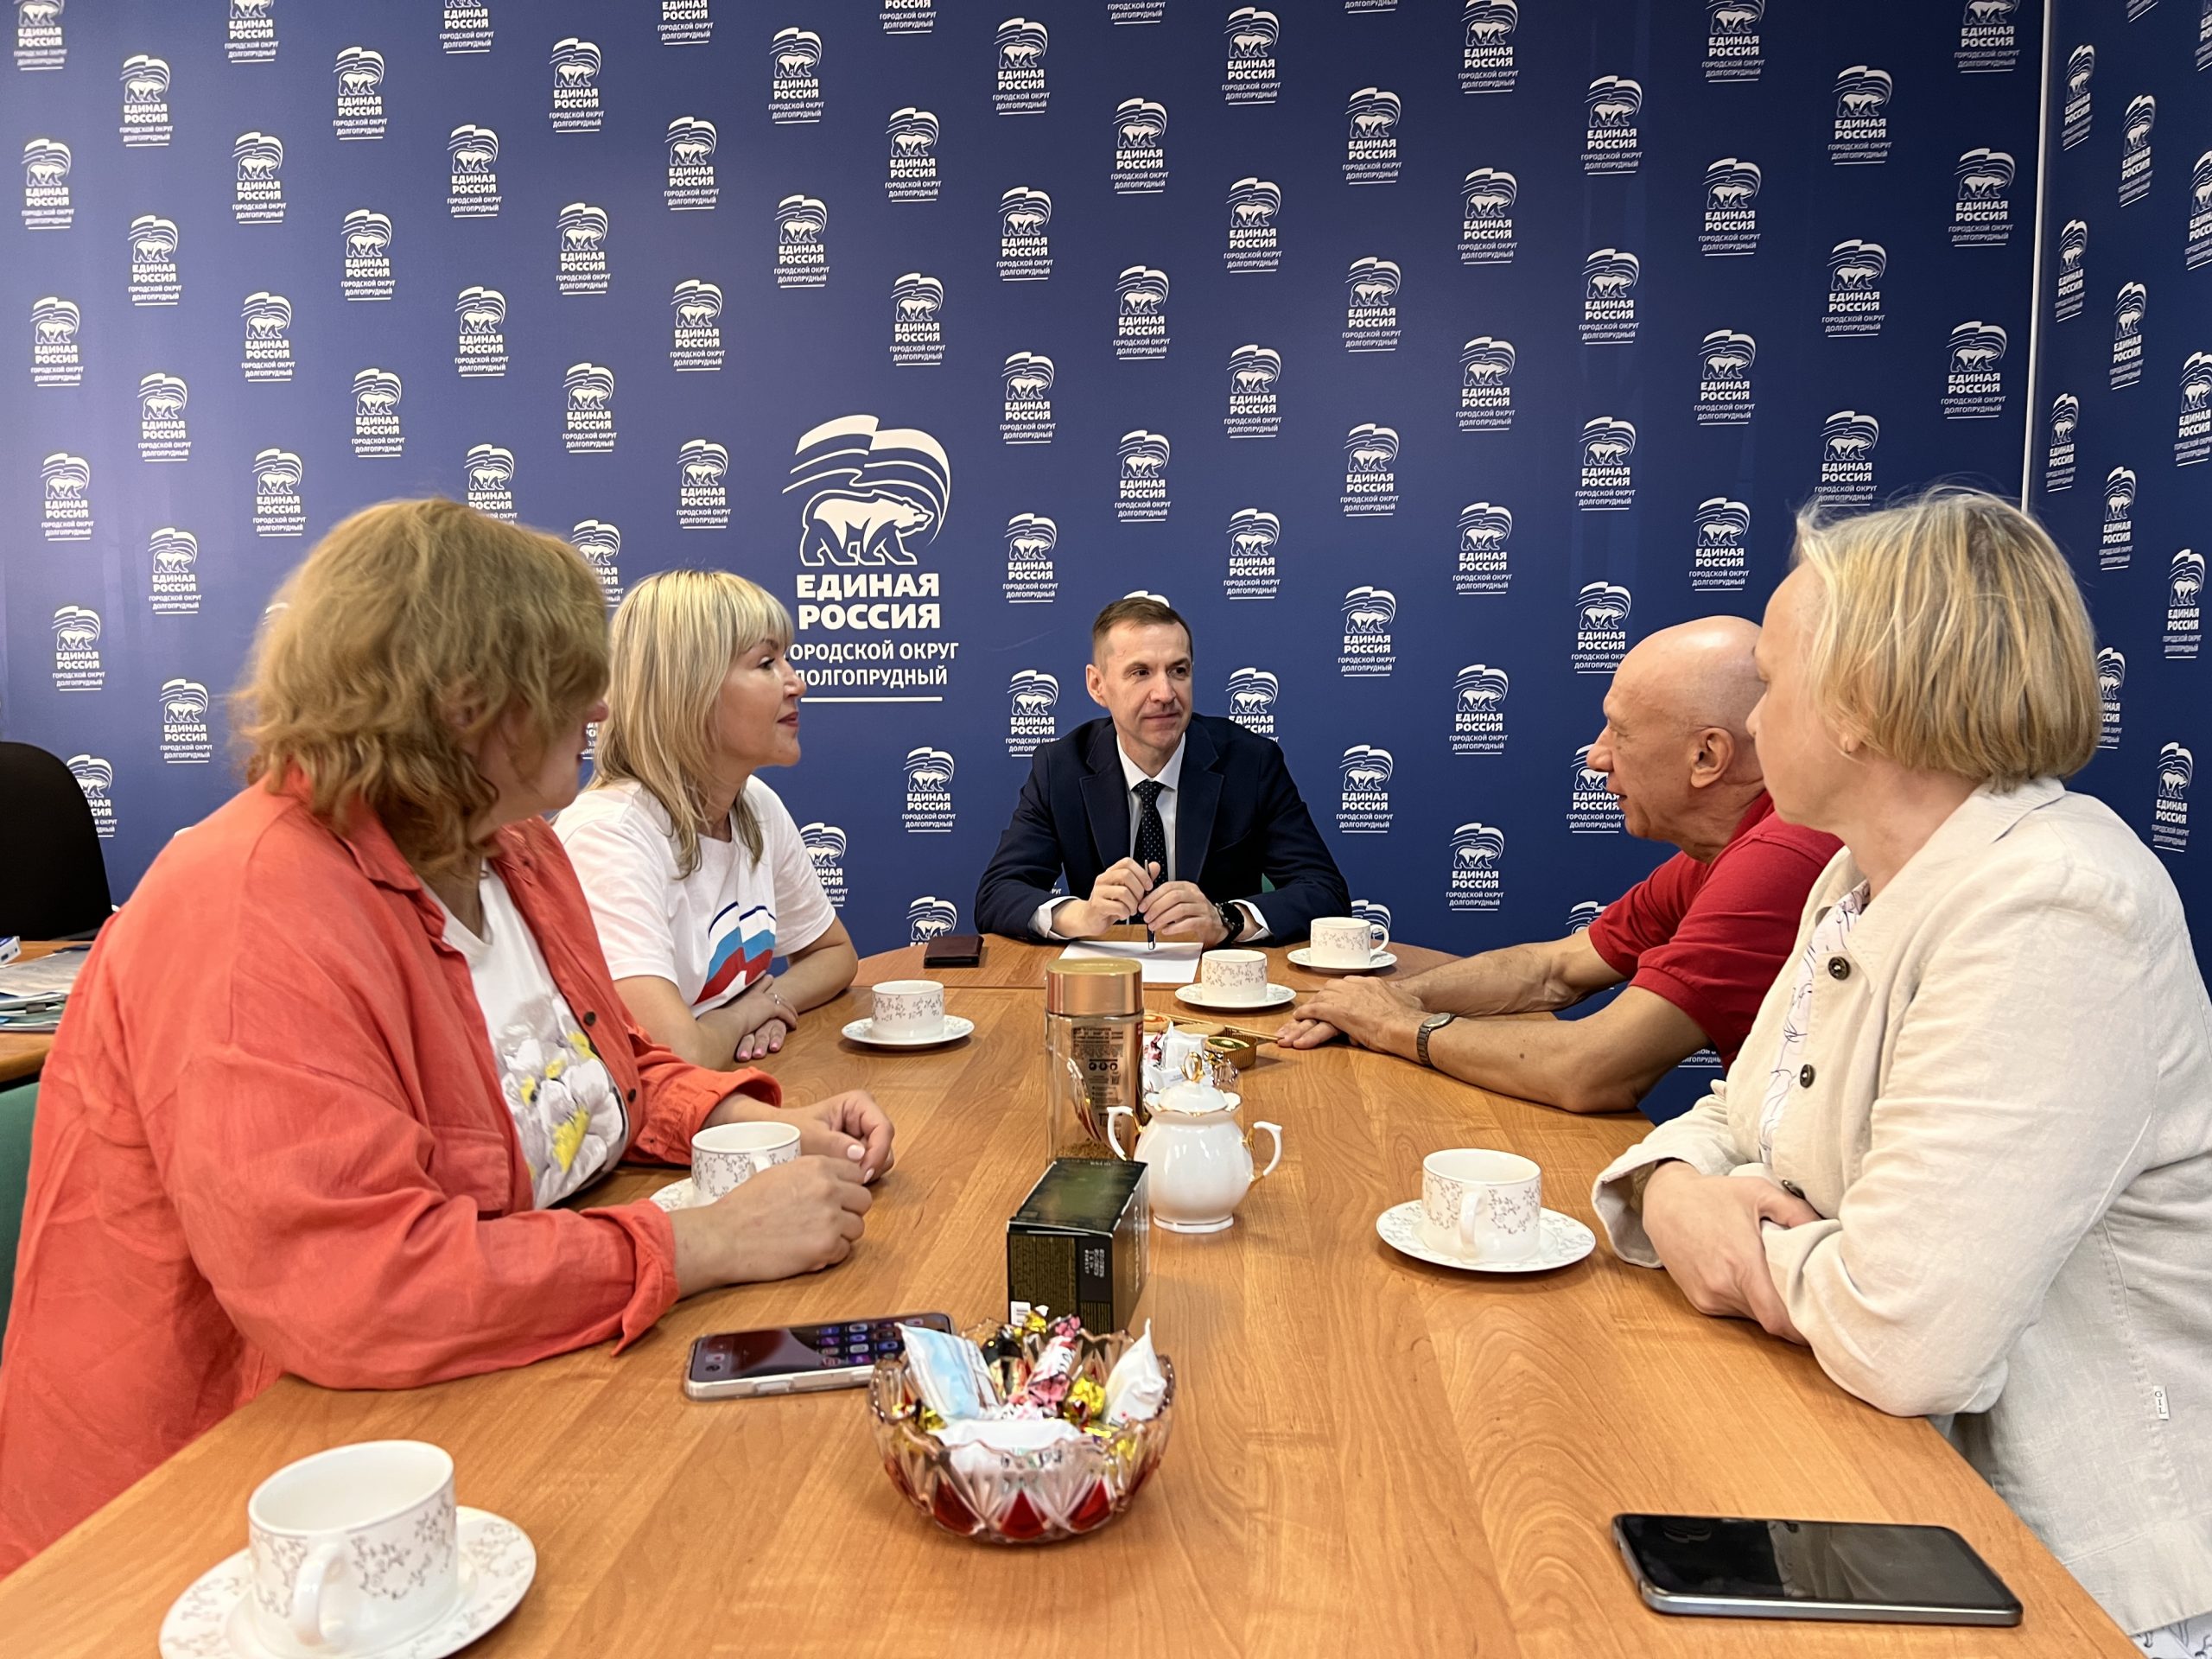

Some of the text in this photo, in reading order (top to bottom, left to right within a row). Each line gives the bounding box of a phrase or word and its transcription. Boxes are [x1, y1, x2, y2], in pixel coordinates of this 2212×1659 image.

[443, 9, 488, 20] ЕДИНАЯ
[444, 18, 489, 29] РОССИЯ
[1464, 46, 1513, 59] ЕДИНАЯ
[1464, 56, 1514, 69] РОССИЯ
[997, 69, 1045, 80] ЕДИНАЯ
[1458, 70, 1497, 80] ГОРОДСКОЙ
[998, 79, 1045, 91] РОССИЯ
[1461, 78, 1516, 89] ДОЛГОПРУДНЫЙ
[553, 88, 599, 99] ЕДИНАЯ
[992, 92, 1029, 101] ГОРОДСКОЙ
[554, 98, 599, 109] РОССИЯ
[995, 100, 1047, 110] ДОЛГОПРУДНЫЙ
[124, 104, 168, 114] ЕДИНАЯ
[124, 113, 168, 124] РОССИЯ
[549, 111, 585, 119] ГОРОДСКОЙ
[552, 118, 601, 128] ДОЛГОПРУДНЫЙ
[1348, 138, 1396, 150] ЕДИНАЯ
[1348, 149, 1396, 161] РОССИЯ
[889, 158, 936, 168] ЕДИНАЯ
[1342, 162, 1381, 171] ГОРОДСКОЙ
[890, 168, 936, 179] РОССИЯ
[1345, 169, 1399, 180] ДОЛГОПРУДНЫЙ
[451, 174, 496, 185] ЕДИНАЯ
[885, 180, 921, 189] ГОРОДСКОЙ
[452, 183, 497, 194] РОССИЯ
[888, 188, 938, 198] ДОЛГОПРУДНЫЙ
[447, 196, 482, 205] ГОРОДСКОЙ
[450, 204, 499, 213] ДОЛГОПРУДНЫЙ
[1955, 200, 2009, 212] ЕДИНАЯ
[1704, 210, 1756, 221] ЕДИНАЯ
[1955, 211, 2008, 222] РОССИЯ
[1705, 220, 1756, 232] РОССИЯ
[1229, 228, 1277, 239] ЕДИНАЯ
[1698, 233, 1738, 243] ГОРОДСКОЙ
[1230, 238, 1277, 249] РОССИЯ
[1701, 241, 1757, 251] ДОЛГОПРУДНЫЙ
[778, 245, 824, 255] ЕДИНАЯ
[1224, 251, 1261, 259] ГОРОДСКОЙ
[345, 258, 390, 269] ЕДИНАЯ
[779, 254, 824, 264] РОССИЯ
[1227, 258, 1279, 268] ДОЛГОПРУДНЫЙ
[346, 268, 391, 277] РОССИЯ
[773, 266, 810, 275] ГОРОДСКОЙ
[777, 274, 827, 283] ДОЛГОПРУДНЫЙ
[1828, 291, 1880, 302] ЕДИНАЯ
[1828, 302, 1880, 313] РОССИЯ
[1347, 308, 1396, 319] ЕДИНАЯ
[1348, 317, 1396, 328] РОССИЯ
[1821, 315, 1862, 324] ГОРОДСКОЙ
[1824, 322, 1881, 333] ДОЛГОПРУДНЫЙ
[1342, 330, 1380, 339] ГОРОДСКОЙ
[245, 340, 289, 350] ЕДИНАЯ
[1345, 338, 1398, 347] ДОЛГОПРУДНЫЙ
[2113, 334, 2142, 353] ЕДИНАЯ
[245, 349, 290, 359] РОССИЯ
[2113, 345, 2141, 364] РОССИЯ
[1947, 372, 2001, 385] ЕДИНАЯ
[1700, 380, 1751, 391] ЕДИНАЯ
[1948, 383, 2000, 395] РОССИЯ
[1229, 394, 1276, 405] ЕДИНАЯ
[1700, 391, 1751, 401] РОССИЯ
[1230, 404, 1277, 415] РОССИЯ
[1694, 403, 1733, 412] ГОРОДСКОЙ
[355, 416, 399, 426] ЕДИНАЯ
[1224, 416, 1261, 425] ГОРОДСКОЙ
[1696, 411, 1751, 421] ДОЛГОПРУДНЫЙ
[2179, 409, 2211, 426] ЕДИНАЯ
[356, 425, 400, 435] РОССИЯ
[1227, 424, 1279, 434] ДОЛГОПРУДНЫЙ
[2178, 421, 2211, 438] РОССИЯ
[1581, 467, 1630, 477] ЕДИНАЯ
[1581, 477, 1630, 487] РОССИЯ
[680, 487, 725, 497] ЕДИНАЯ
[1574, 489, 1614, 498] ГОРОДСКОЙ
[44, 499, 88, 510] ЕДИНАЯ
[681, 497, 726, 506] РОССИЯ
[1578, 497, 1632, 505] ДОЛГОПРУДНЫЙ
[46, 509, 89, 518] РОССИЯ
[679, 516, 728, 524] ДОЛГОПРУДНЫЙ
[2103, 520, 2132, 533] ЕДИНАЯ
[2102, 531, 2131, 544] РОССИЯ
[1694, 548, 1745, 557] ЕДИНАЯ
[1229, 557, 1275, 567] ЕДИНАЯ
[1695, 557, 1745, 568] РОССИЯ
[1229, 567, 1275, 576] РОССИЯ
[1688, 569, 1727, 578] ГОРОДСКОЙ
[796, 573, 940, 601] ЕДИНАЯ
[1223, 578, 1260, 587] ГОРОДСКОЙ
[1226, 586, 1277, 594] ДОЛГОПРУДНЫЙ
[798, 603, 941, 630] РОССИЯ
[2168, 607, 2200, 620] ЕДИНАЯ
[2167, 620, 2199, 631] РОССИЯ
[1343, 634, 1391, 645] ЕДИНАЯ
[1578, 632, 1625, 641] ЕДИНАЯ
[1344, 644, 1391, 654] РОССИЯ
[1578, 641, 1625, 651] РОССИЯ
[785, 639, 959, 664] ОРОДСКОЙ ОКРУГ
[1571, 652, 1609, 661] ГОРОДСКОЙ
[1340, 664, 1393, 672] ДОЛГОПРУДНЫЙ
[1010, 716, 1055, 727] ЕДИНАЯ
[1455, 713, 1503, 722] ЕДИНАЯ
[163, 724, 207, 733] ЕДИНАЯ
[1011, 725, 1055, 735] РОССИЯ
[1455, 722, 1503, 732] РОССИЯ
[164, 733, 207, 742] РОССИЯ
[906, 792, 950, 802] ЕДИНАЯ
[907, 802, 951, 810] РОССИЯ
[2156, 798, 2188, 812] ЕДИНАЯ
[2156, 810, 2187, 824] РОССИЯ
[1451, 870, 1499, 880] ЕДИНАЯ
[1452, 880, 1499, 888] РОССИЯ
